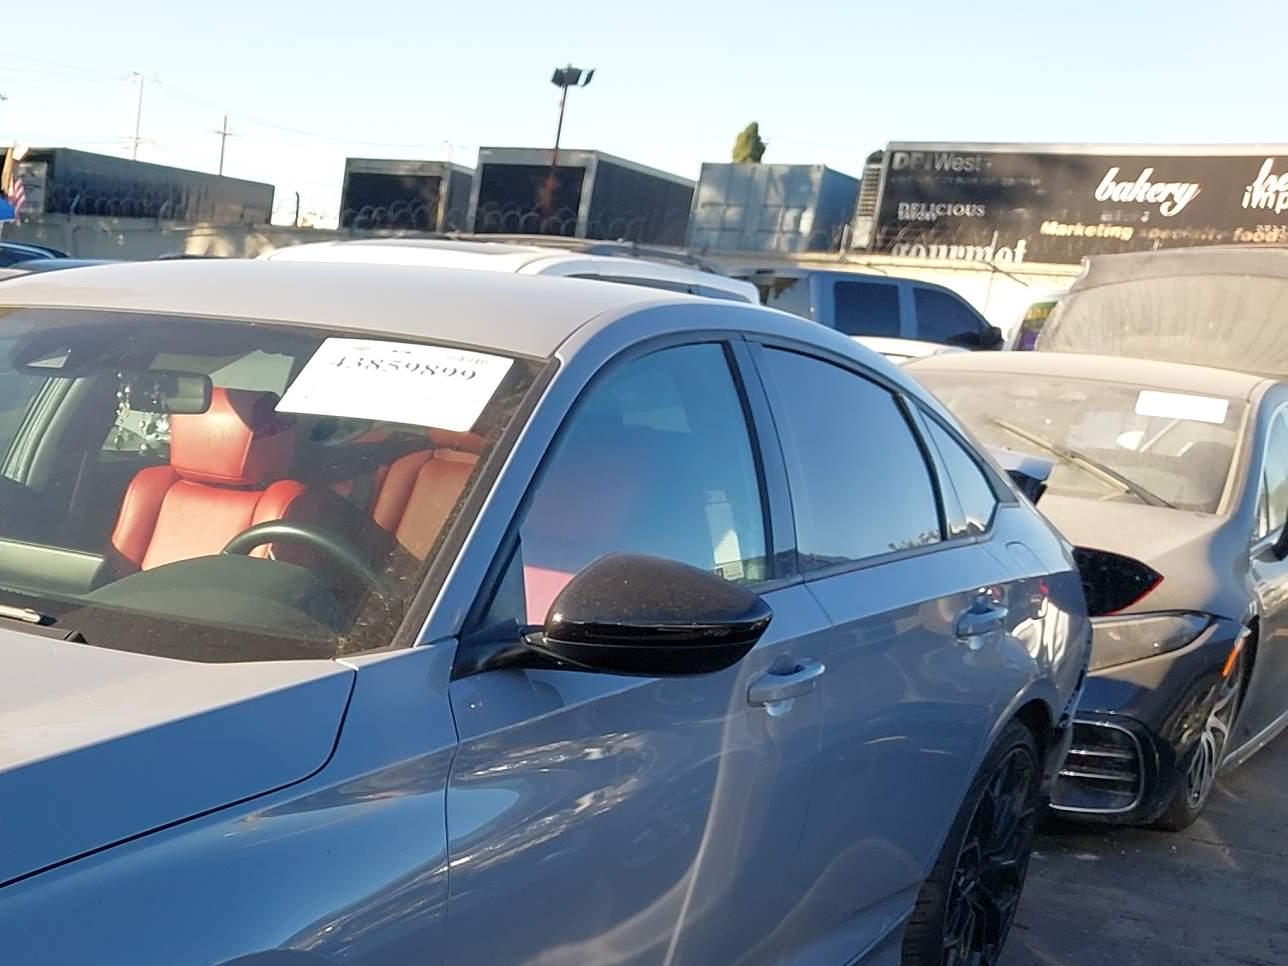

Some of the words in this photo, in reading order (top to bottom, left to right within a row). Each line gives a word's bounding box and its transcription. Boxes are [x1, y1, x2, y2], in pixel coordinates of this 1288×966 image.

[1095, 167, 1202, 217] bakery
[898, 202, 986, 218] DELICIOUS
[1039, 221, 1134, 241] Marketing
